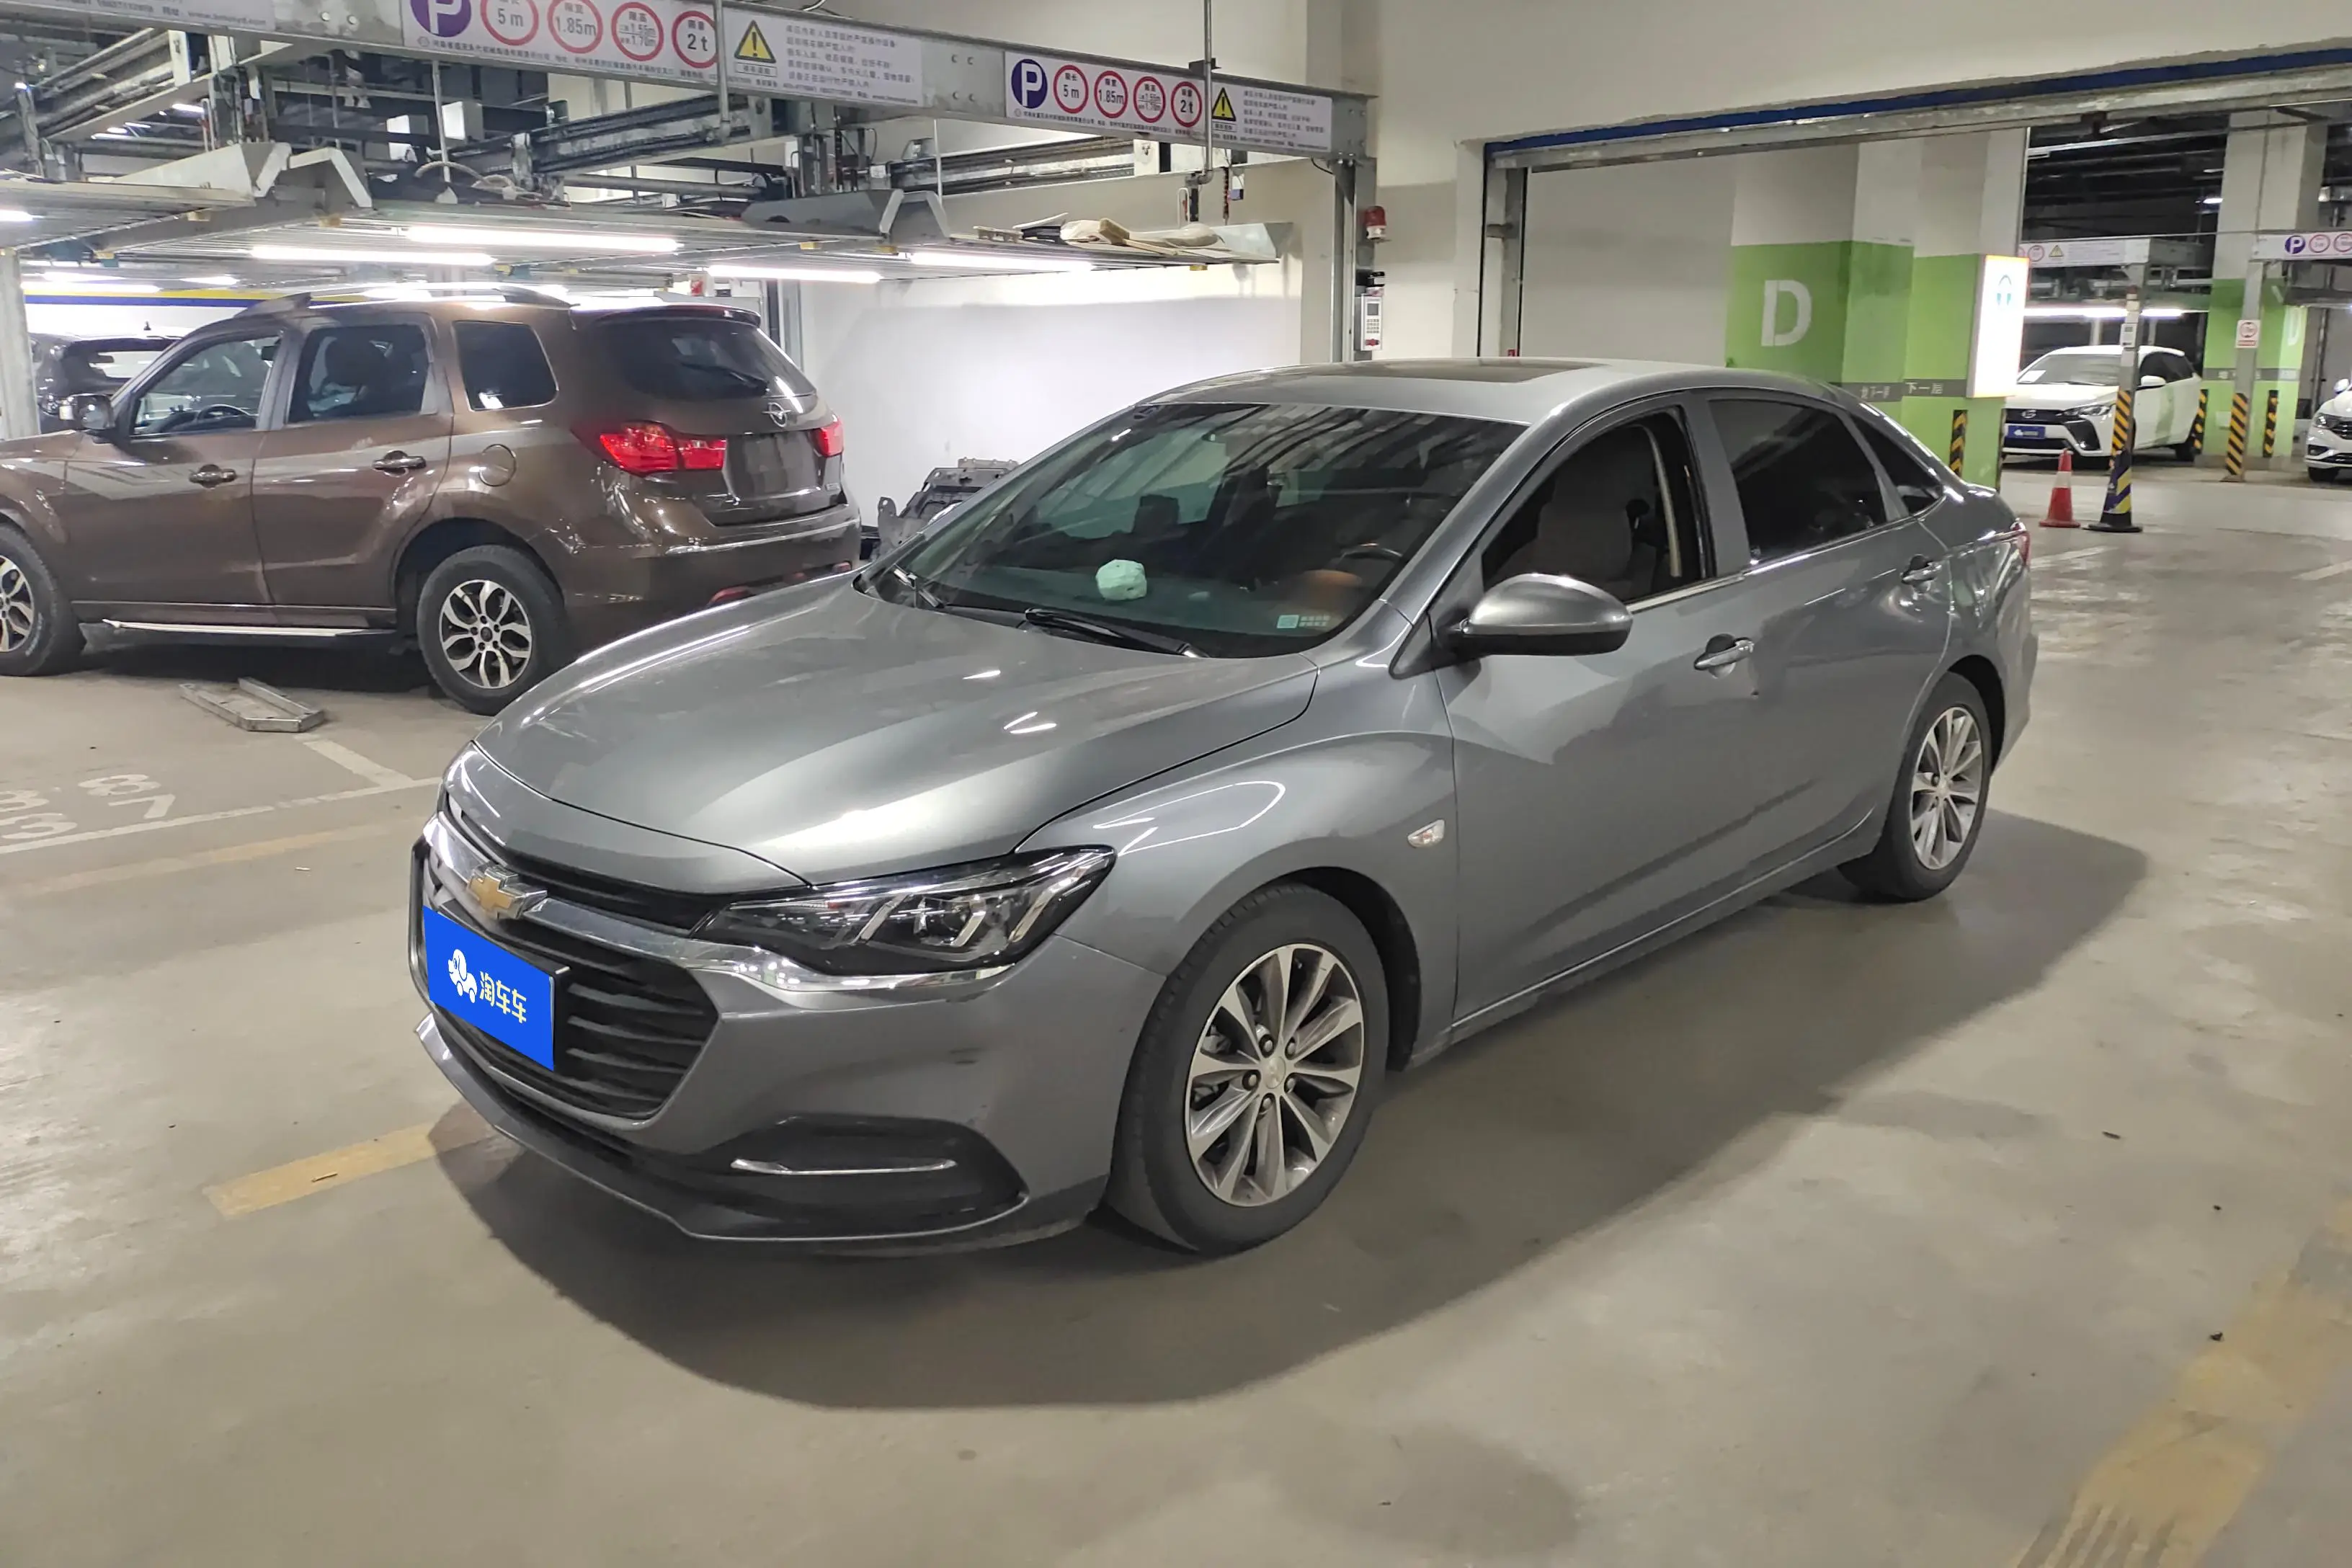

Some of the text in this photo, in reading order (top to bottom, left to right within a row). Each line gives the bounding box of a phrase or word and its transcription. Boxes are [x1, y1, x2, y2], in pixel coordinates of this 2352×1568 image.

[628, 11, 648, 22] 限高
[554, 17, 597, 36] 1.85m
[1020, 62, 1043, 107] P
[1064, 73, 1078, 81] 限长
[1097, 89, 1124, 105] 1.85m
[1761, 280, 1813, 347] D
[1905, 381, 1943, 395] 下一层
